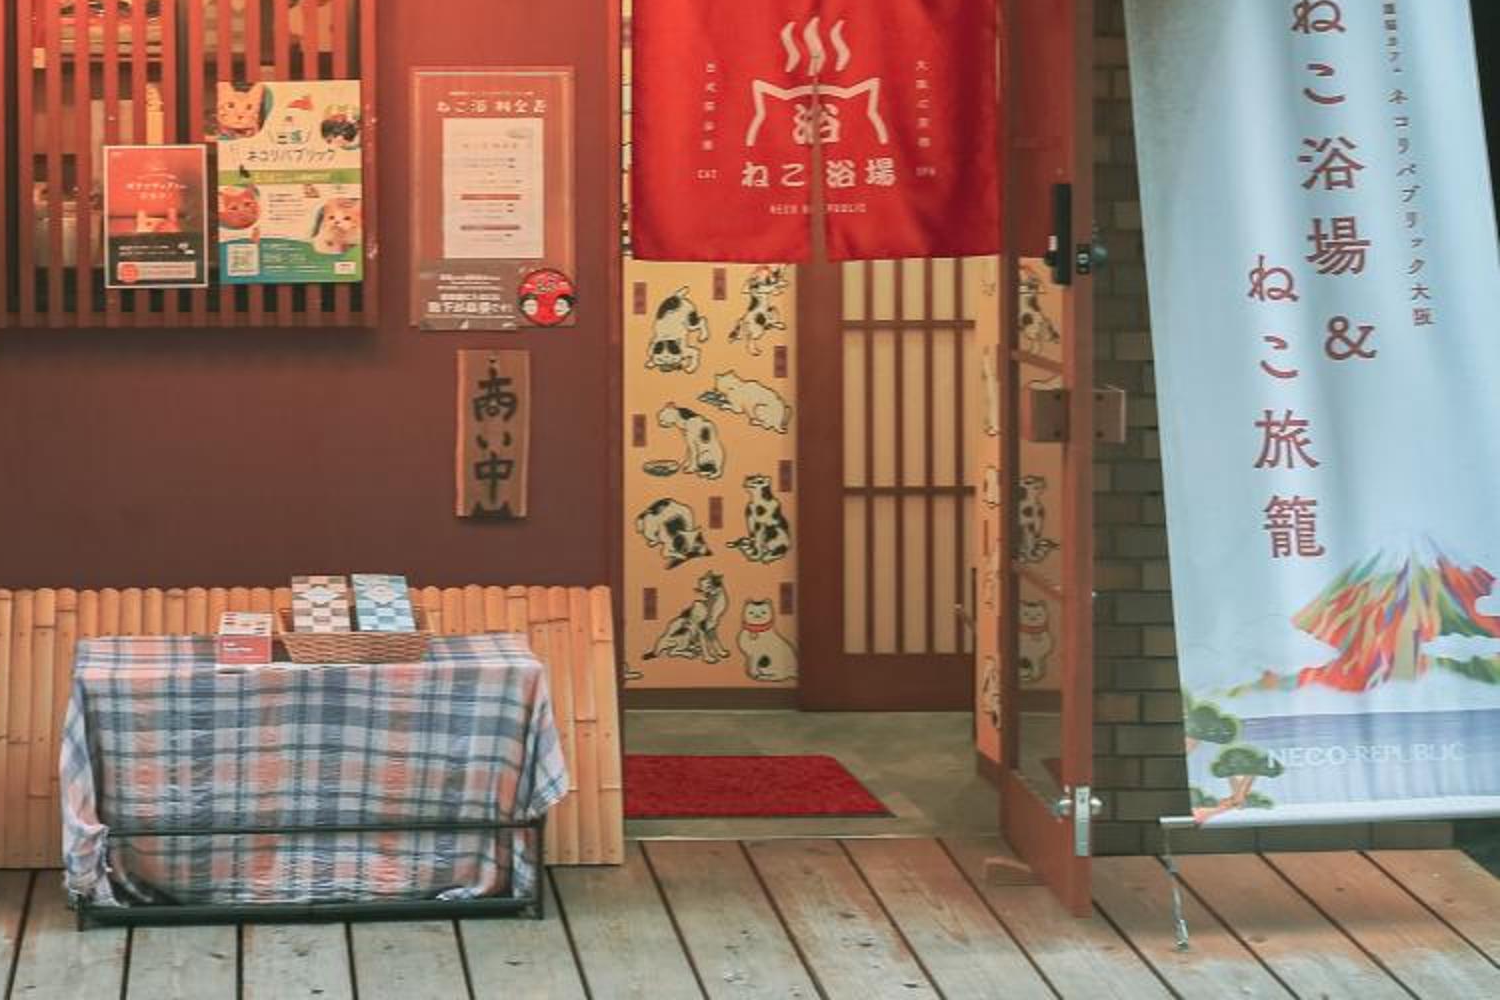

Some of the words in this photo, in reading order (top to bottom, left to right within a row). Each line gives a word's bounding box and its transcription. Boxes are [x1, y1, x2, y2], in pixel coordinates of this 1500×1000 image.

[741, 159, 896, 189] ねこ浴場
[1247, 254, 1326, 559] ねこ旅籠
